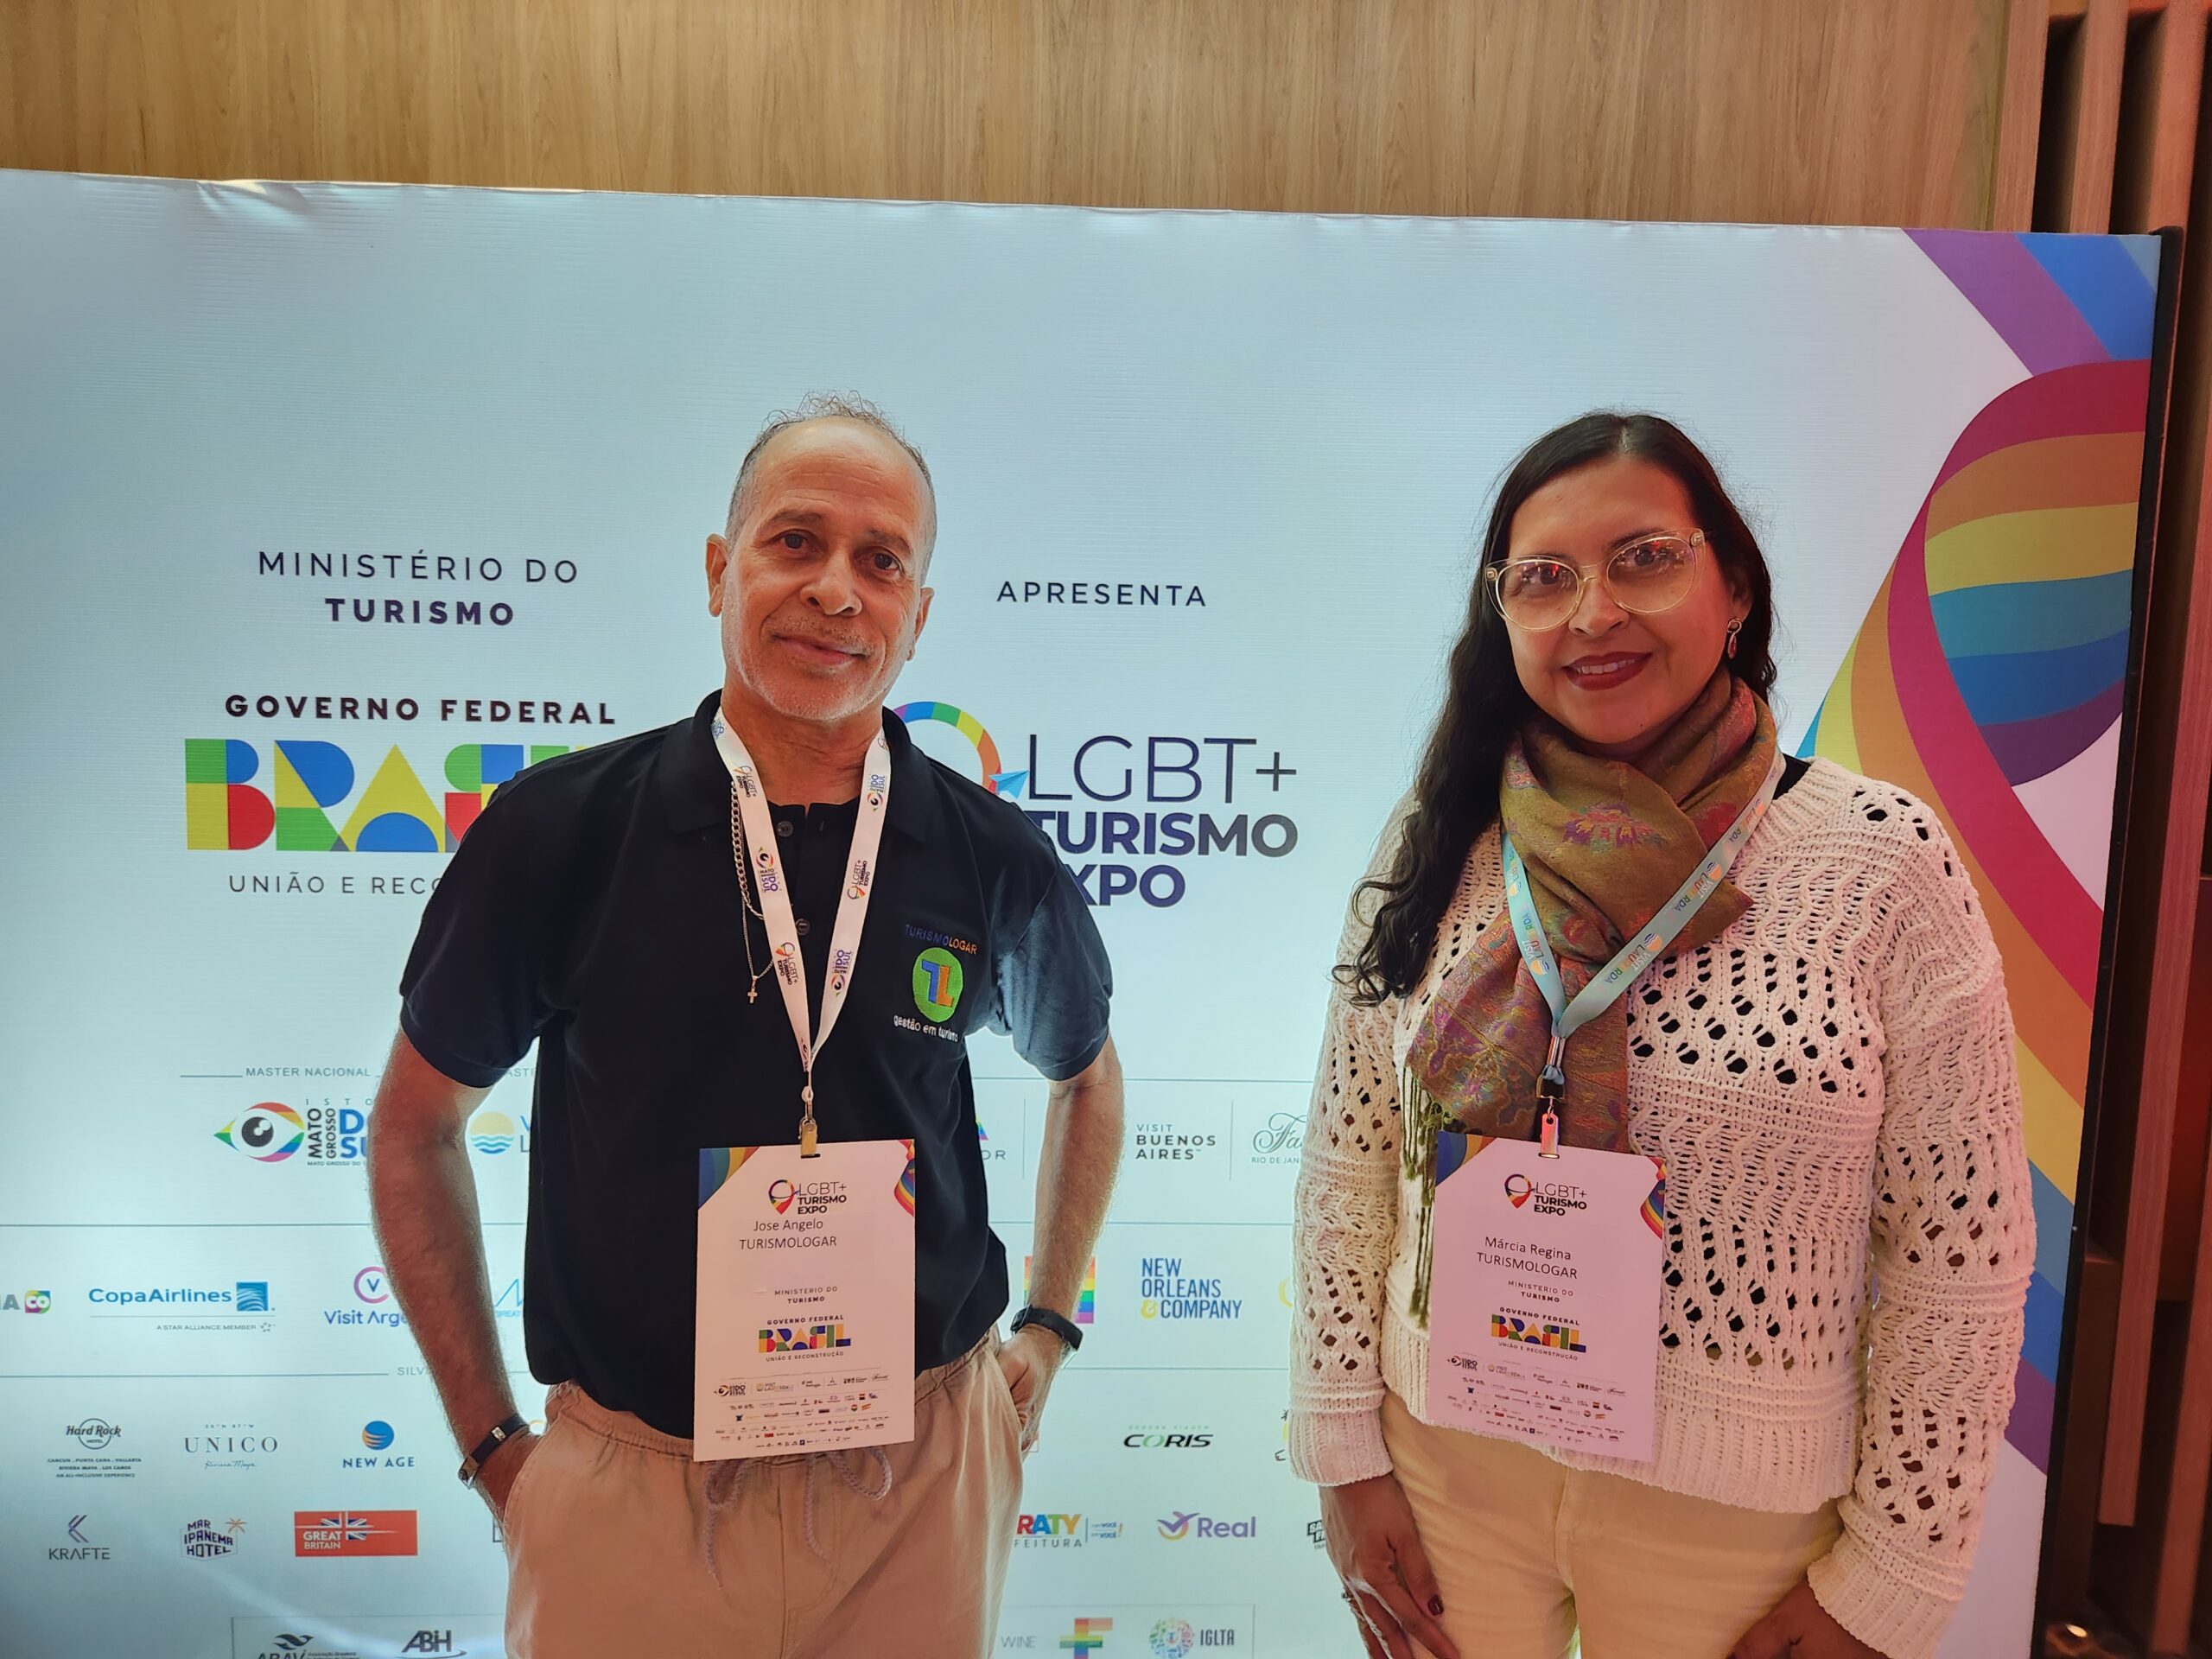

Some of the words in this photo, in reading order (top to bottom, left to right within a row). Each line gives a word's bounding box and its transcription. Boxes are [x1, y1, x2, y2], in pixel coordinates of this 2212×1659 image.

[259, 549, 504, 582] MINISTÉRIO
[524, 558, 577, 583] DO
[996, 581, 1205, 607] APRESENTA
[325, 597, 514, 626] TURISMO
[225, 695, 419, 721] GOVERNO
[441, 699, 616, 724] FEDERAL
[1027, 734, 1297, 804] LGBT+
[228, 872, 325, 894] UNIÃO
[342, 876, 355, 894] E
[372, 877, 442, 895] REC
[1064, 863, 1185, 907] XPO
[893, 1014, 921, 1032] gestão
[923, 1024, 937, 1036] em
[245, 1067, 300, 1077] MASTER
[304, 1067, 372, 1077] NACIONAL
[308, 1108, 322, 1159] MATO
[325, 1108, 337, 1159] GROSSO
[1136, 1123, 1173, 1132] VISIT
[1135, 1135, 1217, 1147] BUENOS
[1135, 1148, 1195, 1160] AIRES
[798, 1181, 847, 1196] LGBT+
[1535, 1181, 1587, 1199] LGBT+
[798, 1194, 847, 1205] TURISMO
[1534, 1195, 1587, 1211] TURISMO
[798, 1205, 828, 1215] EXPO
[1534, 1204, 1566, 1217] EXPO
[753, 1220, 779, 1231] Jose
[783, 1218, 823, 1232] Angelo
[740, 1236, 837, 1249] TURISMOLOGAR
[1484, 1236, 1527, 1253] Márcia
[1530, 1238, 1572, 1261] Regina
[1141, 1257, 1182, 1277] NEW
[1476, 1252, 1578, 1280] TURISMOLOGAR
[1141, 1279, 1221, 1298] ORLEANS
[787, 1296, 825, 1305] TURISMO
[1521, 1291, 1560, 1303] TURISMO
[324, 1309, 364, 1325] Visit
[766, 1317, 806, 1325] GOVERNO
[1499, 1306, 1540, 1319] GOVERNO
[1542, 1314, 1580, 1326] FEDERAL
[758, 1323, 851, 1353] BRASIL
[1491, 1313, 1586, 1353] BRASIL
[397, 1367, 425, 1376] SILV
[66, 1425, 94, 1437] Hard
[95, 1425, 122, 1437] Rock
[184, 1436, 278, 1453] UNICO
[1123, 1434, 1214, 1448] CORIS
[342, 1457, 378, 1468] NEW
[385, 1457, 415, 1467] AGE
[188, 1519, 211, 1531] MAR
[1016, 1514, 1082, 1535] RATY
[1198, 1516, 1256, 1538] Real
[184, 1530, 233, 1546] IPANEMA
[303, 1530, 342, 1541] GREAT
[187, 1543, 232, 1558] HOTEL
[304, 1541, 341, 1550] BRITAIN
[1200, 1629, 1236, 1646] IGLTA
